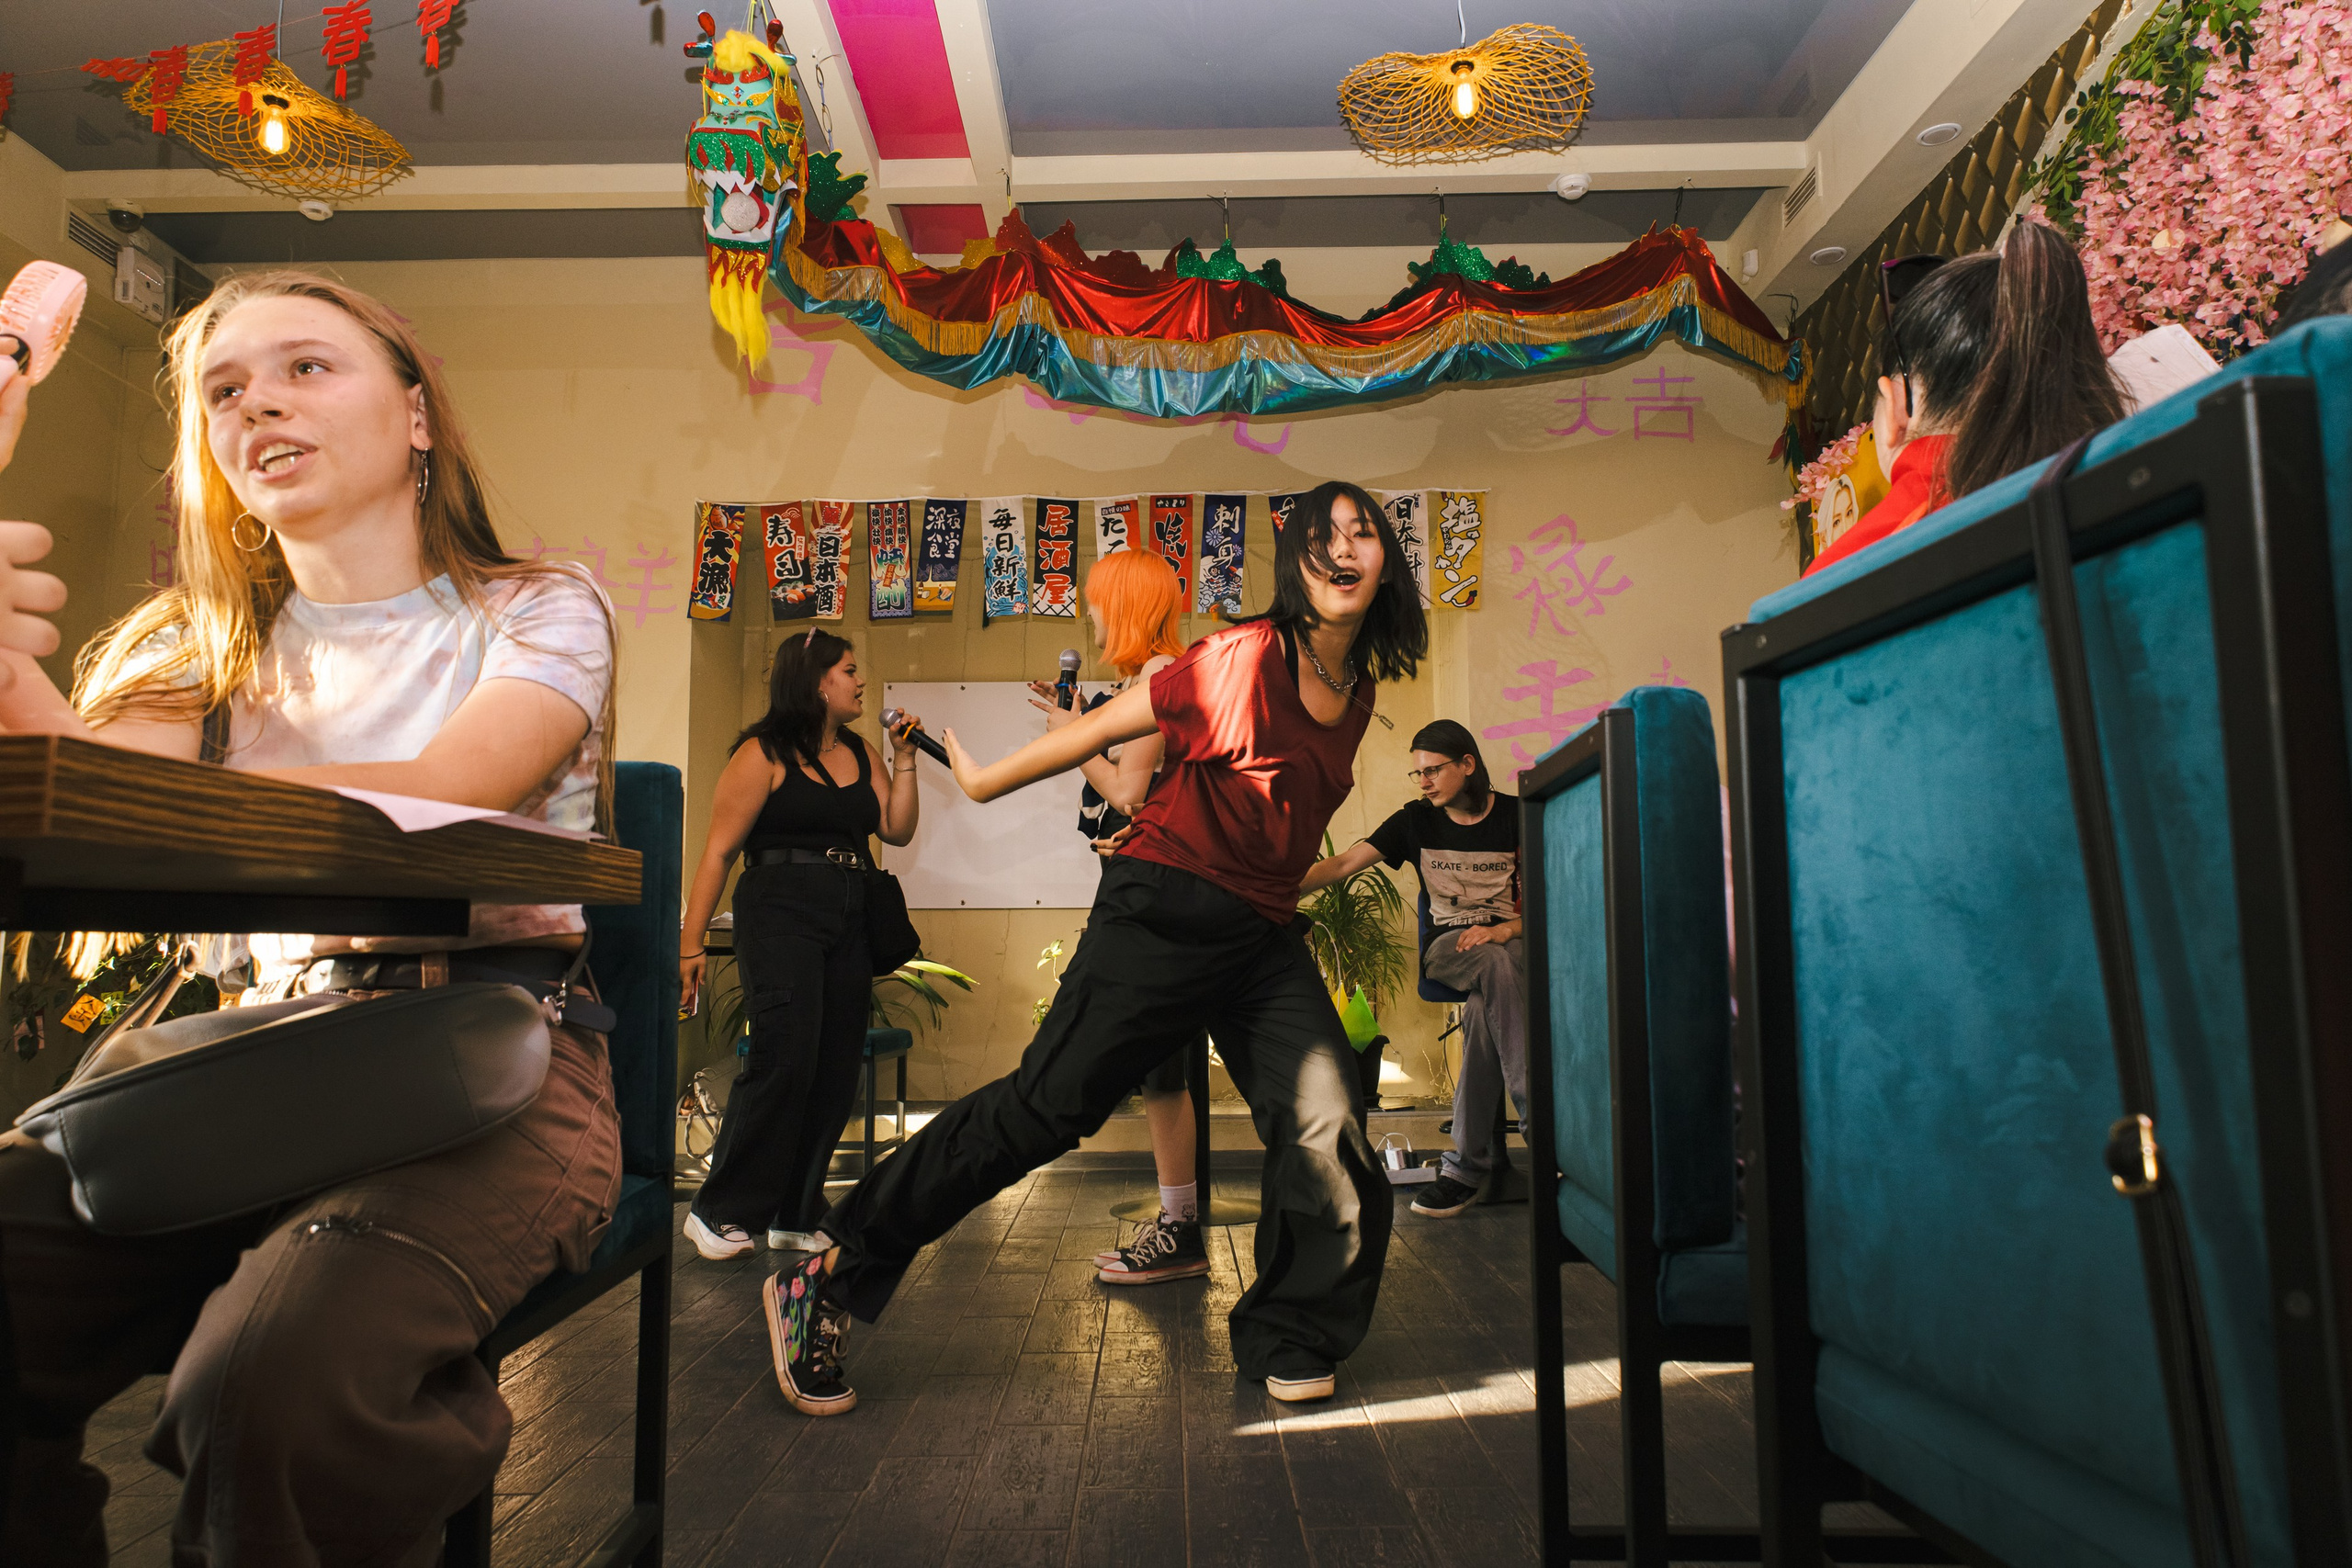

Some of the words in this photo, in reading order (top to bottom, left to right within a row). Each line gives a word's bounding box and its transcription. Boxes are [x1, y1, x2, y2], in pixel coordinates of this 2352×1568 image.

[234, 23, 276, 86] 春
[322, 0, 372, 66] 春
[150, 44, 188, 104] 春
[696, 530, 735, 594] 大漁
[766, 513, 803, 579] 寿司
[989, 508, 1022, 602] 毎日新鮮
[1037, 504, 1074, 605] 居酒屋
[1211, 503, 1241, 569] 刺身
[813, 535, 842, 614] 日本酒
[1430, 860, 1462, 872] SKATE
[1472, 862, 1508, 872] BORED
